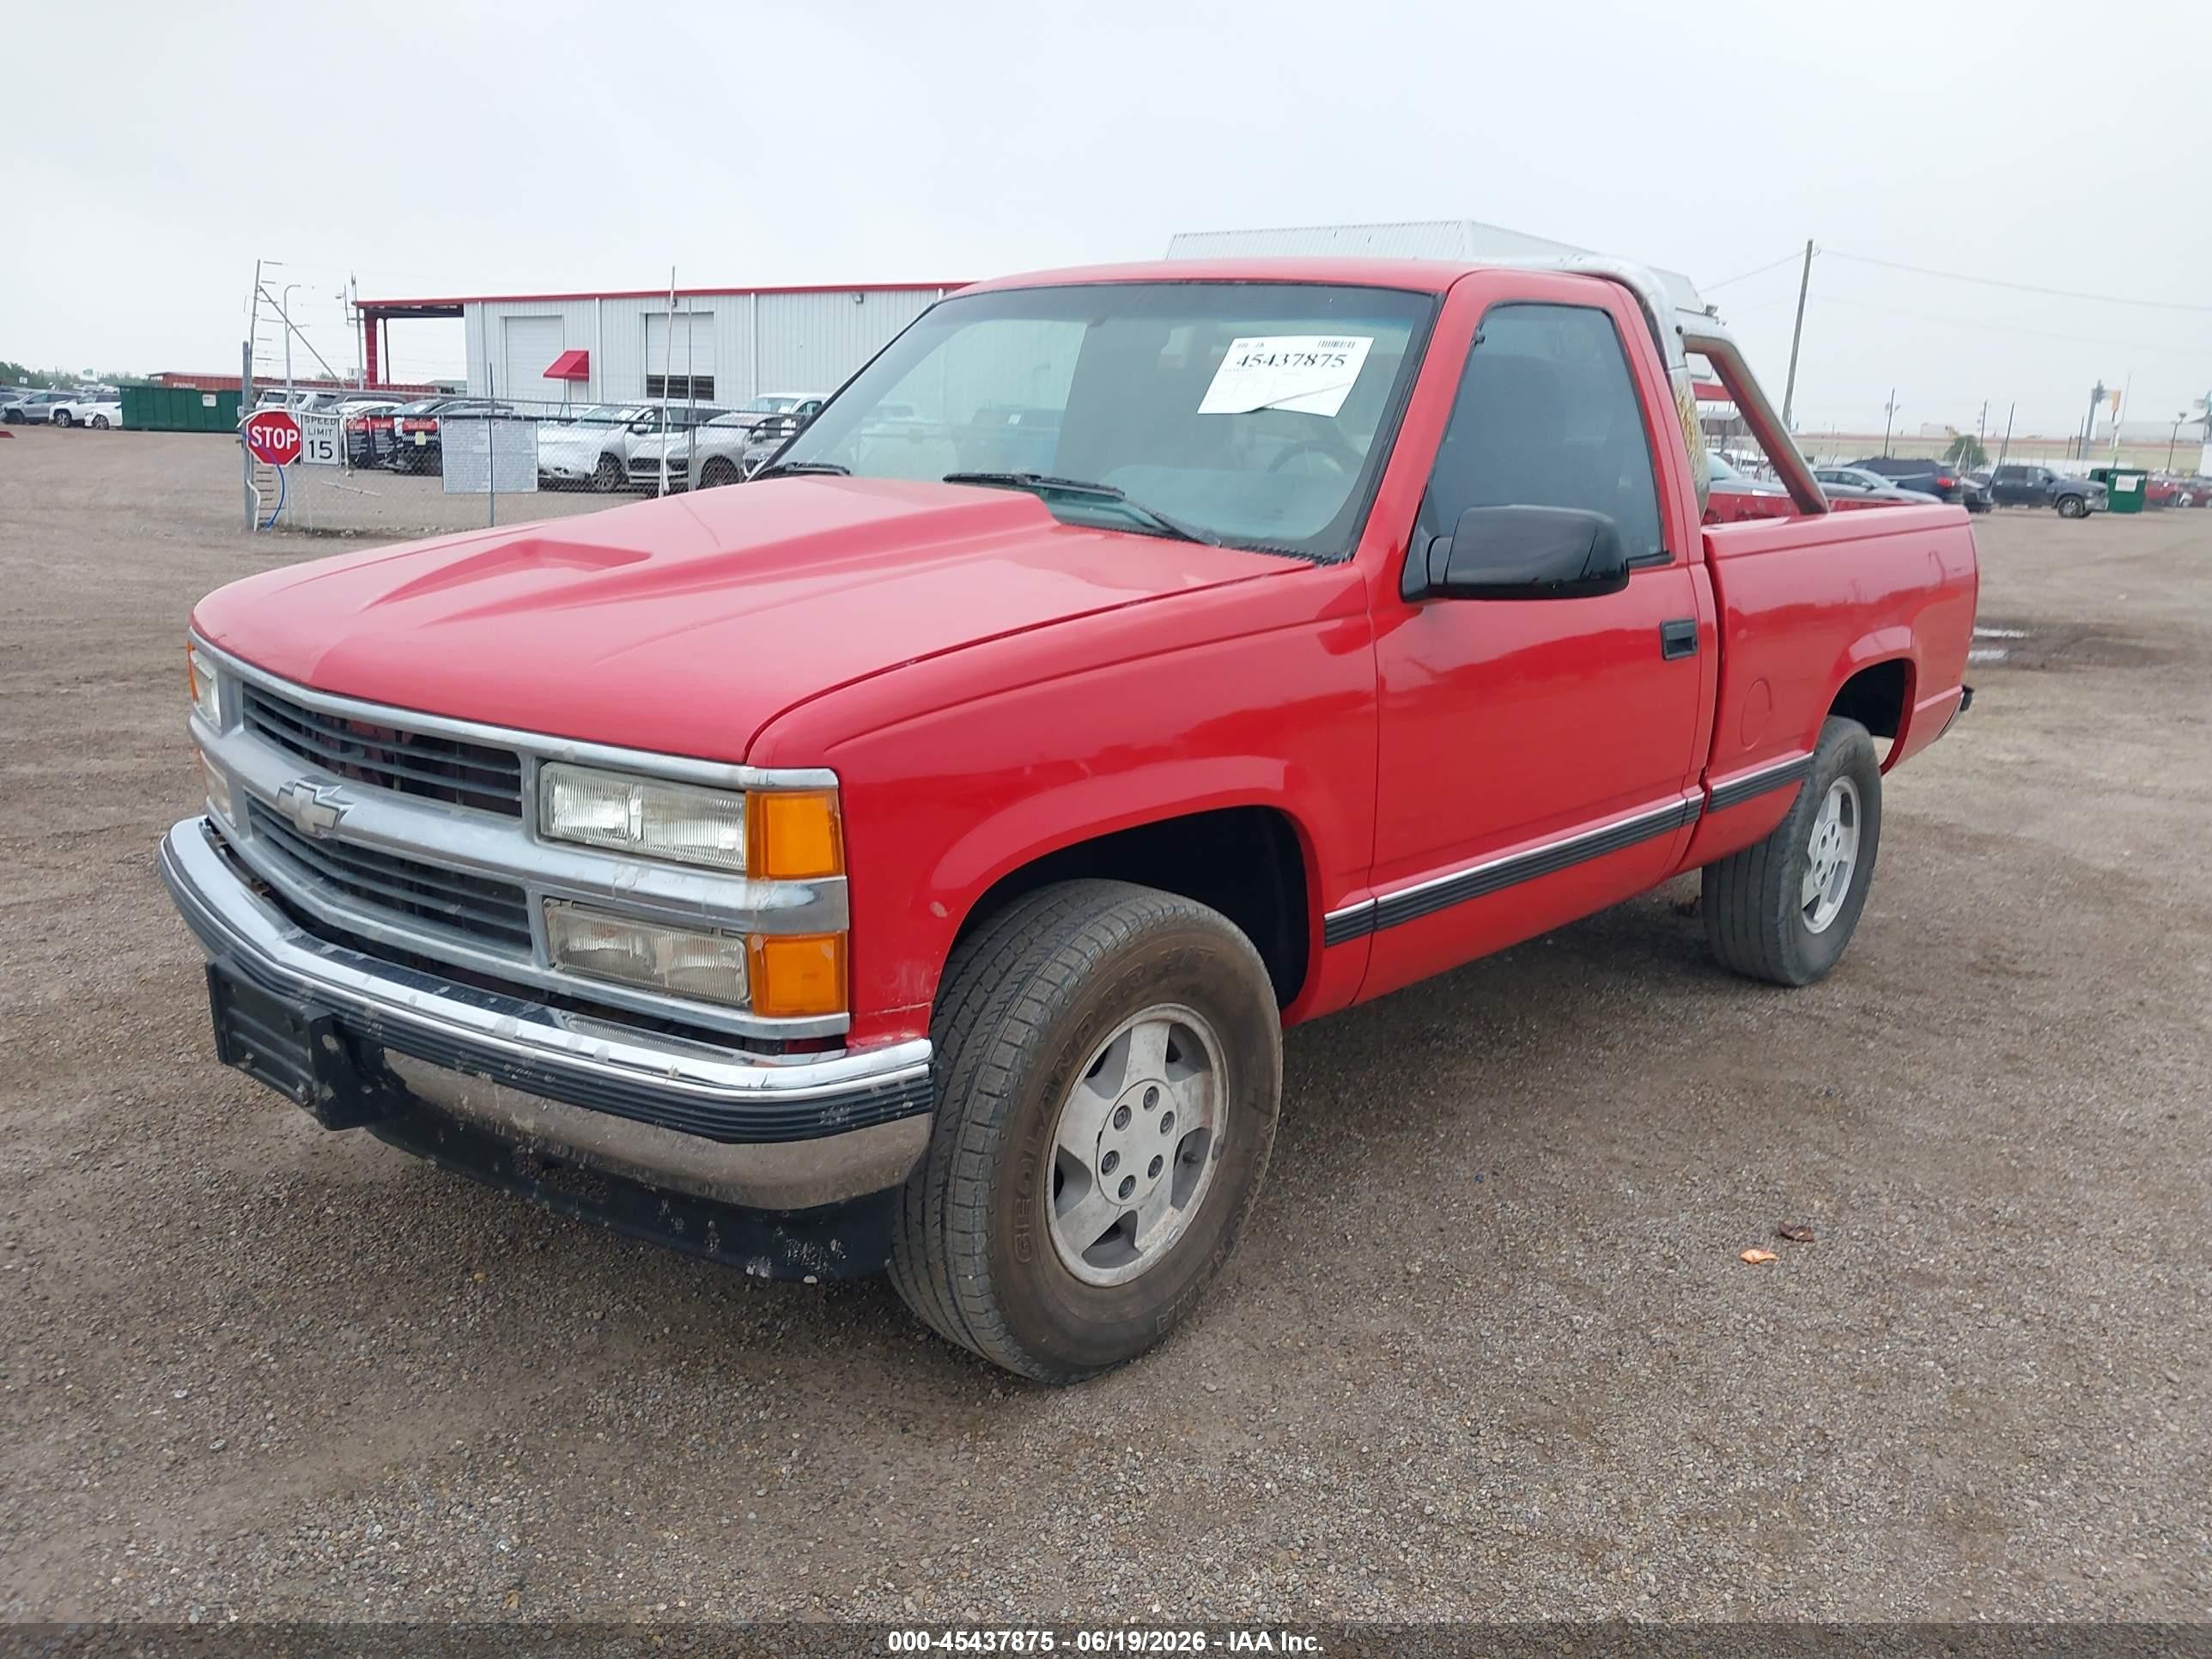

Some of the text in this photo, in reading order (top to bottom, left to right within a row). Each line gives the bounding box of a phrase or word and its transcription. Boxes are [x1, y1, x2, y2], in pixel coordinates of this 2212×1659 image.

[1237, 353, 1347, 368] 45437875
[304, 416, 337, 426] SPEED
[251, 425, 299, 450] STOP
[307, 428, 333, 437] LIMIT
[308, 439, 333, 459] 15
